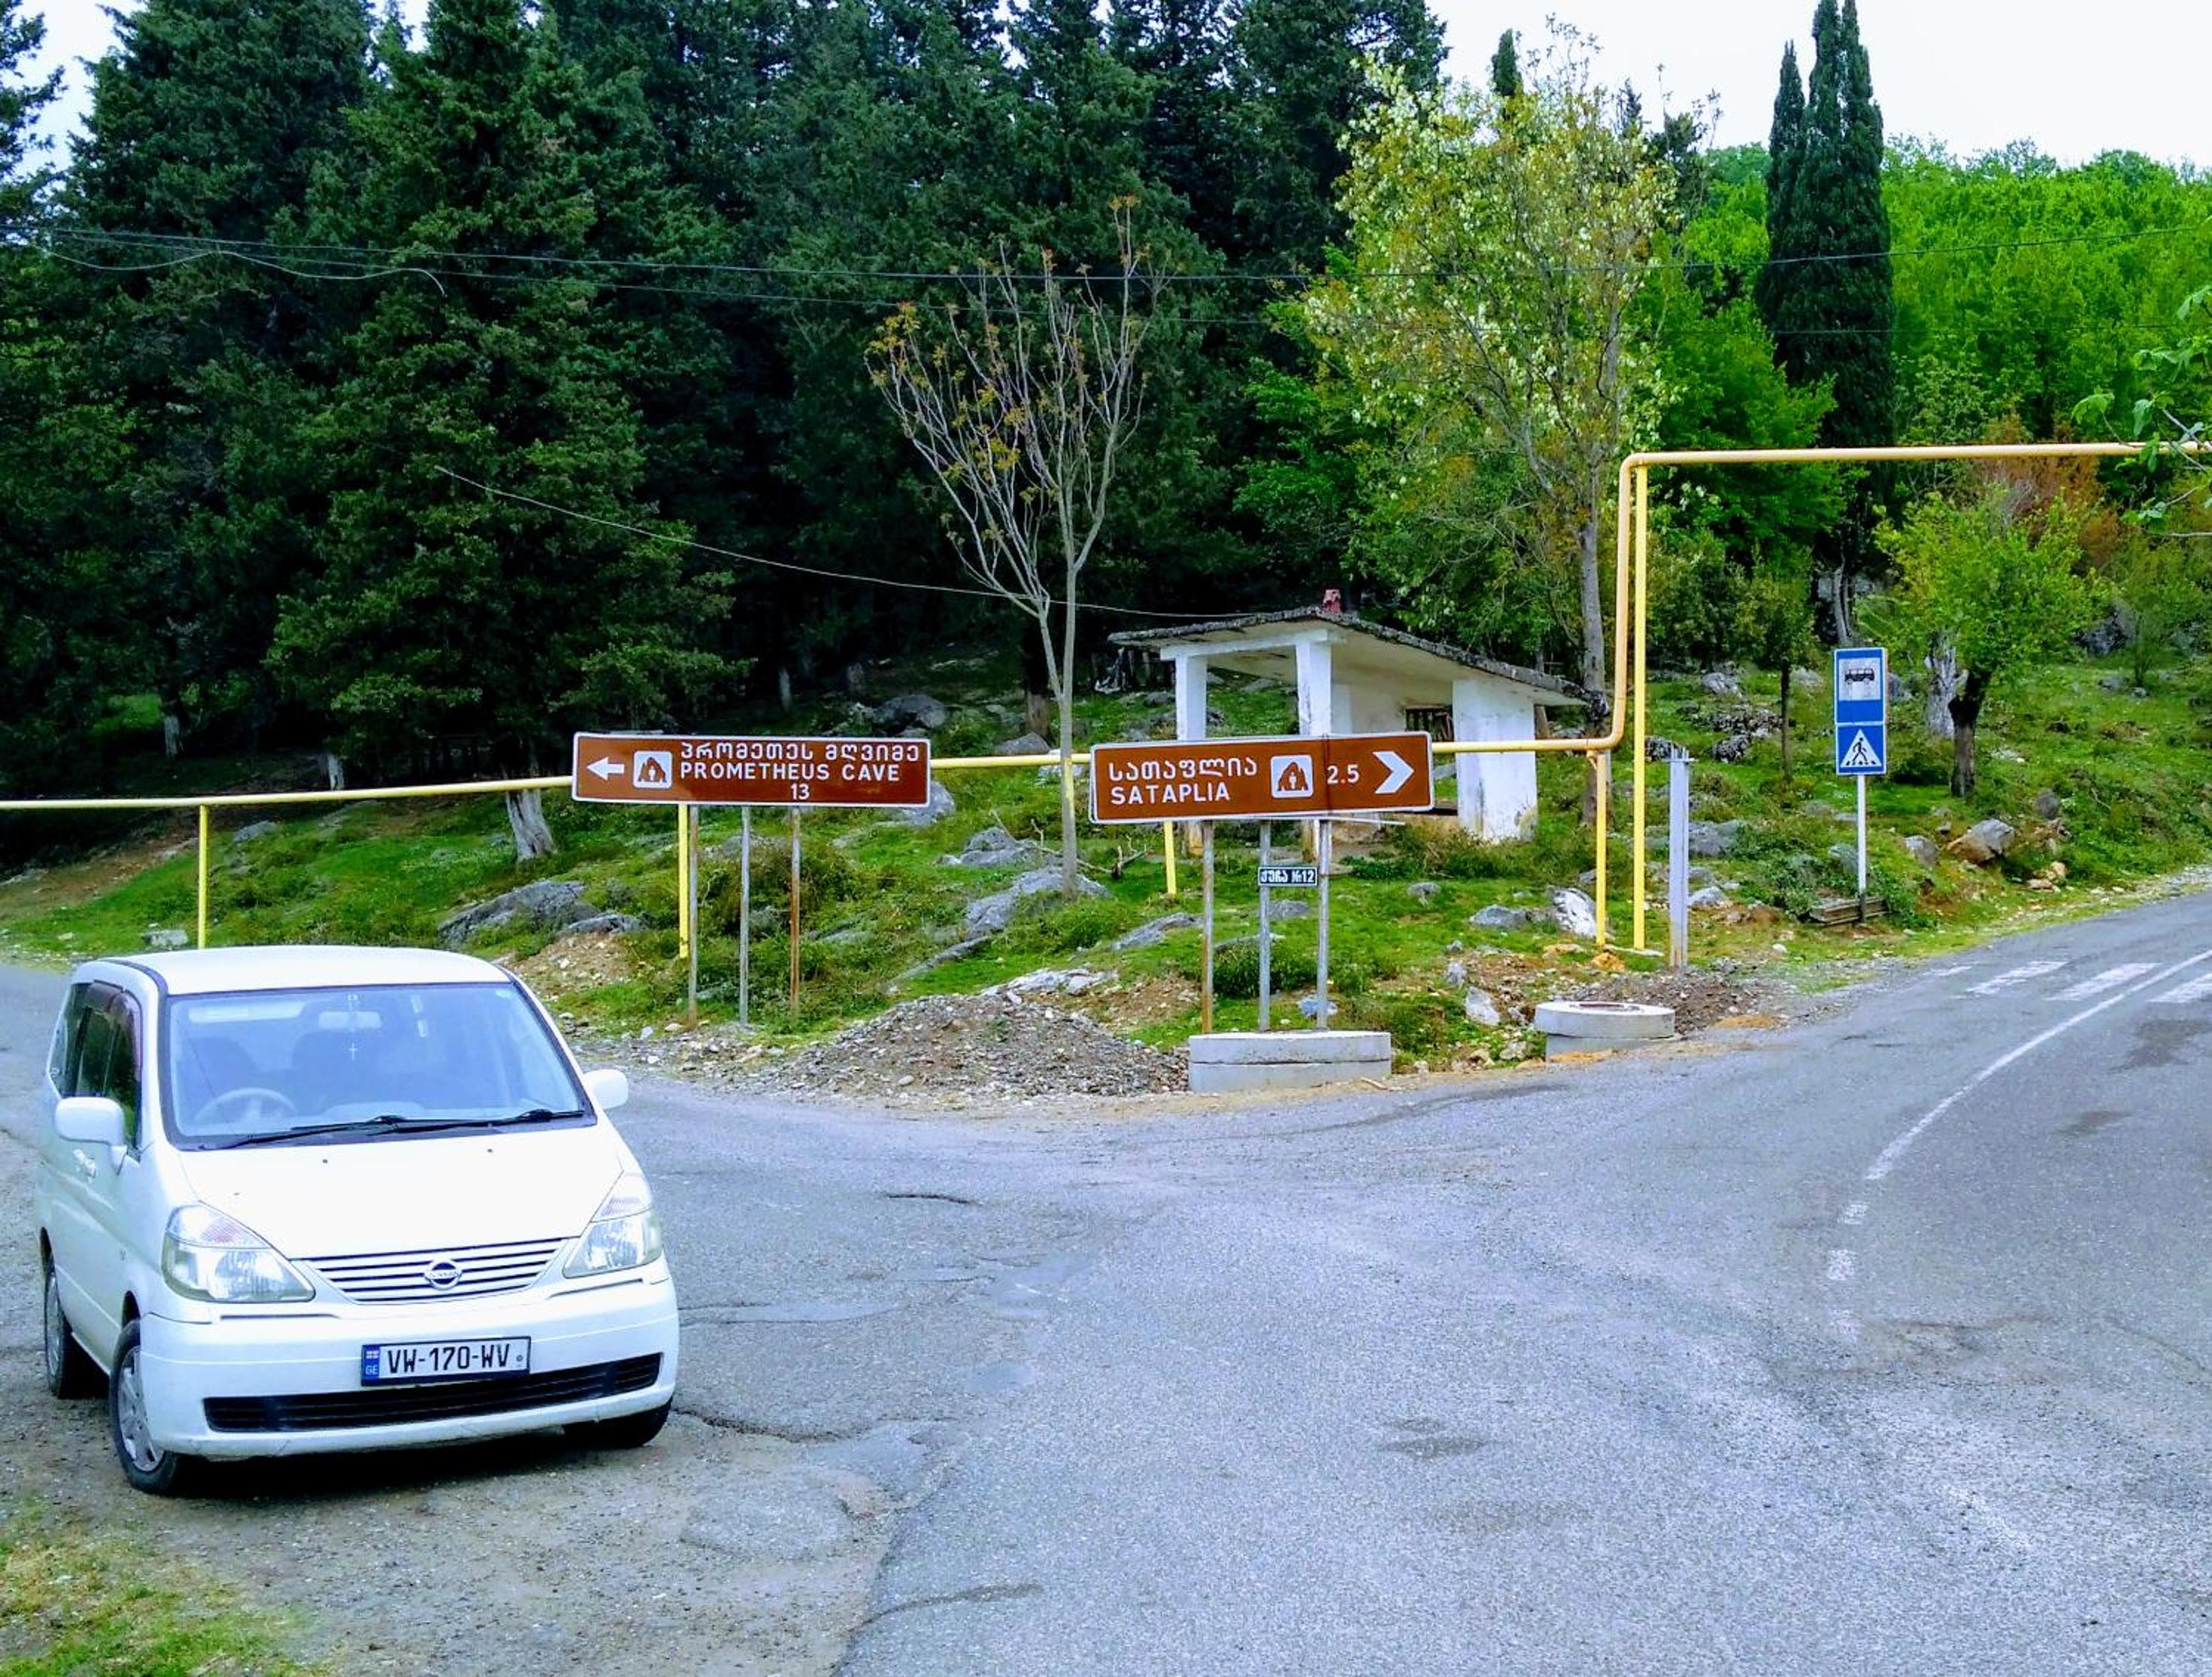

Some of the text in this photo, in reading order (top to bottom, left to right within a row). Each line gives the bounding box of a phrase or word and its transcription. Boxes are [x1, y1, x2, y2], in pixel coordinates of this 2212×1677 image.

[680, 741, 919, 762] პრომეთეს მღვიმე
[680, 761, 899, 781] PROMETHEUS CAVE
[1108, 757, 1257, 781] სათაფლია
[1326, 763, 1360, 784] 2.5
[790, 783, 811, 800] 13
[1111, 781, 1231, 805] SATAPLIA
[388, 1343, 511, 1374] VW-170-WV
